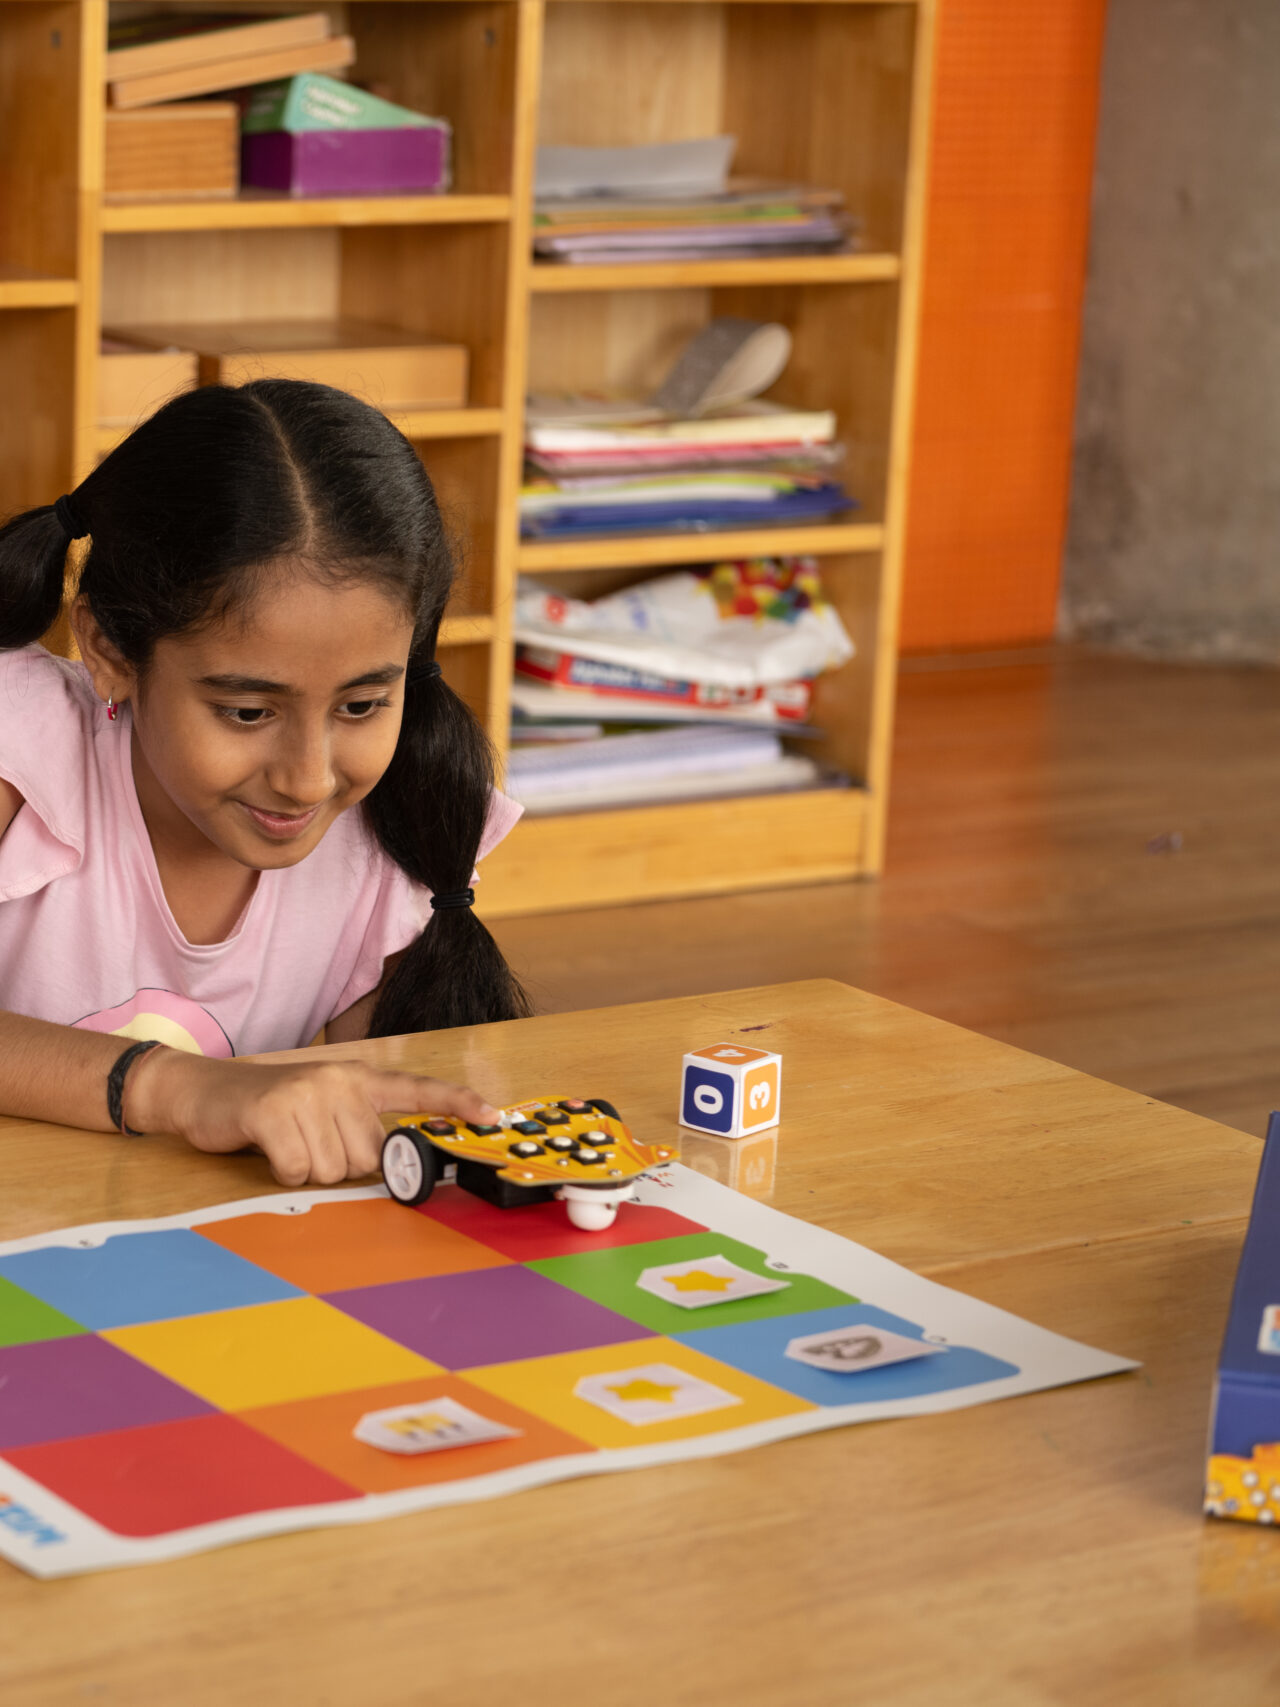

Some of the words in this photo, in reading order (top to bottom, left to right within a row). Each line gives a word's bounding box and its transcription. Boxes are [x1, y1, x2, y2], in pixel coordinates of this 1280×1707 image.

[712, 1048, 747, 1059] 4
[693, 1084, 724, 1115] 0
[749, 1081, 771, 1110] 3
